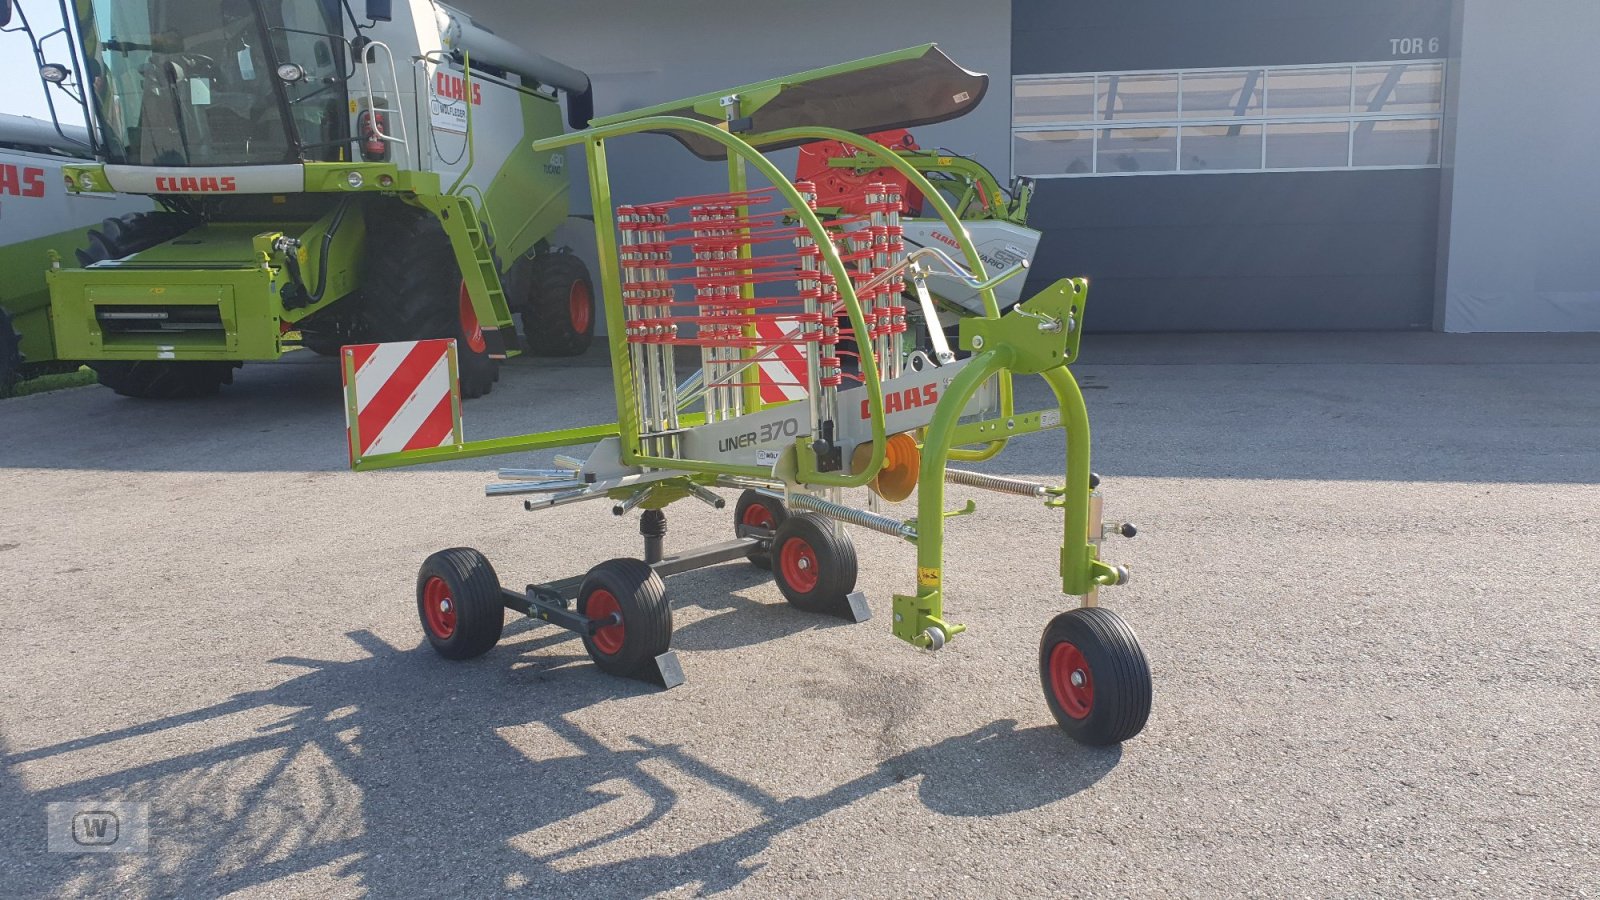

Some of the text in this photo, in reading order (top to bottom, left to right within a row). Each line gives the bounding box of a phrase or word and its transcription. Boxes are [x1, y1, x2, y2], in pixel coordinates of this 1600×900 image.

[1390, 37, 1440, 55] TOR 6
[155, 176, 236, 192] CLAAS
[930, 231, 961, 250] CLAAS
[861, 383, 938, 420] CAAS
[718, 417, 799, 453] LINER 370
